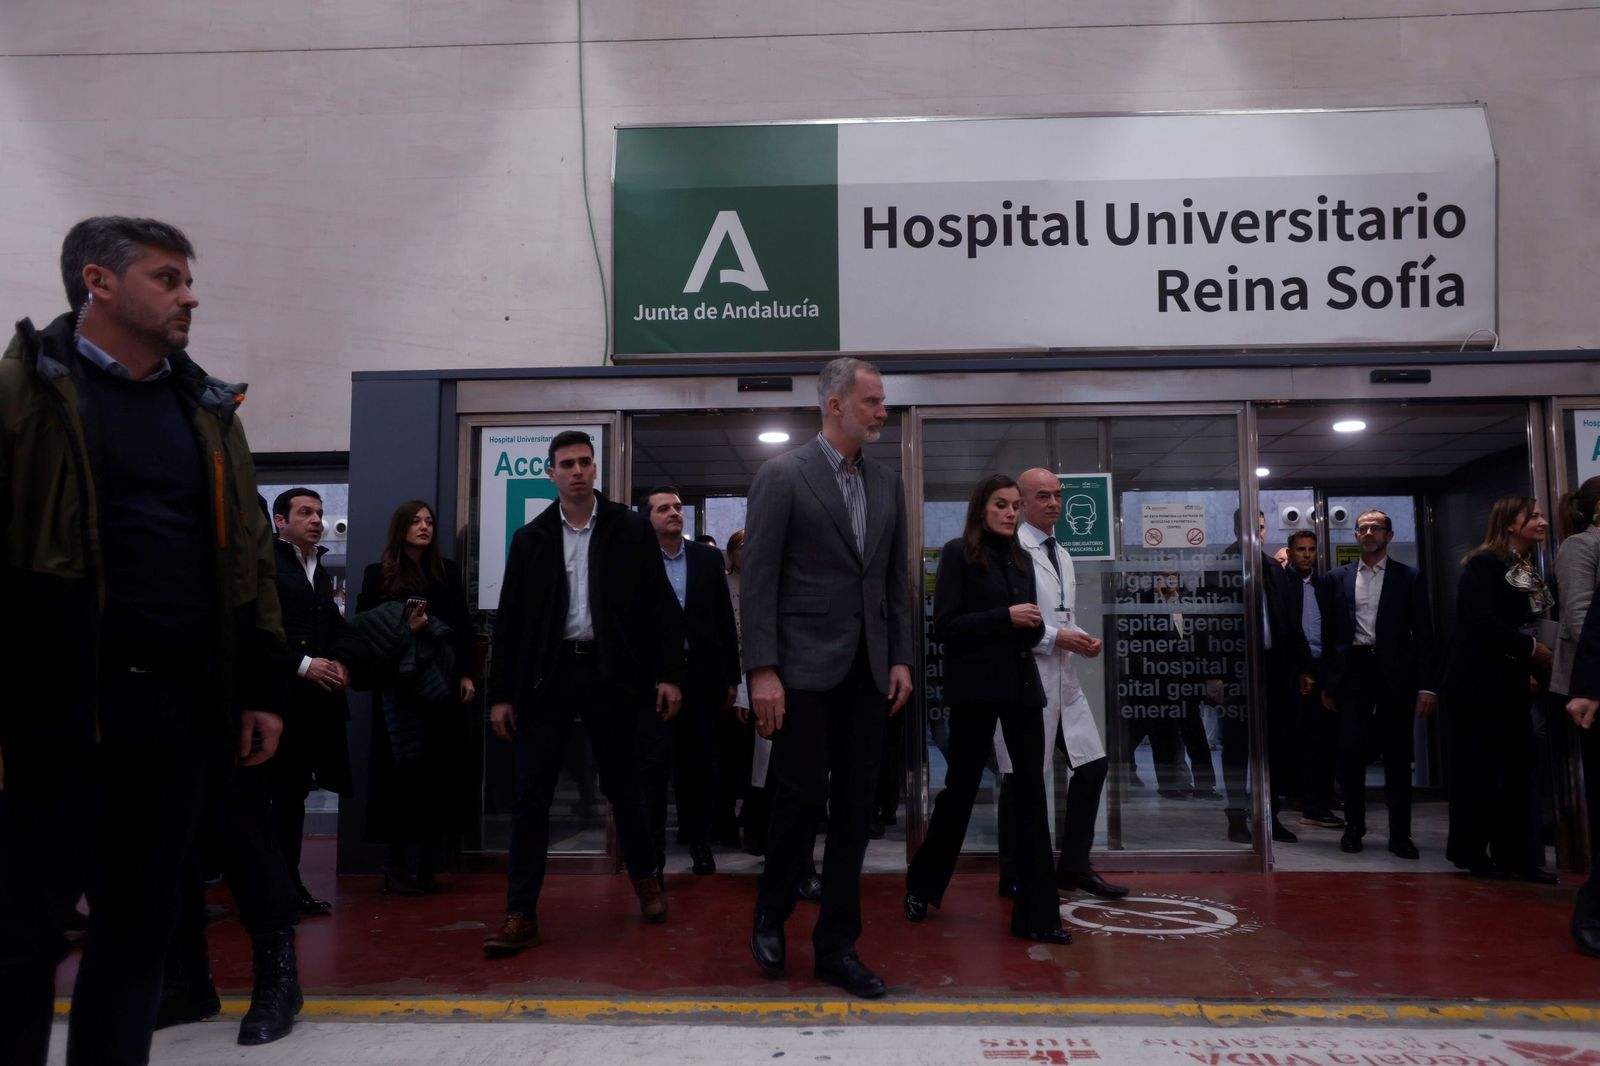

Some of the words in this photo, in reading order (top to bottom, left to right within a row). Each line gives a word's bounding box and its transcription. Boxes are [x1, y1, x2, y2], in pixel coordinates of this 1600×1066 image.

[863, 199, 1089, 259] Hospital
[1105, 192, 1466, 247] Universitario
[1157, 265, 1308, 313] Reina
[1326, 254, 1465, 311] Sofía
[633, 304, 689, 321] Junta
[693, 302, 718, 320] de
[721, 297, 820, 319] Andalucía
[488, 435, 516, 444] Hospital
[516, 434, 554, 443] Universitari
[1116, 636, 1195, 657] general
[1142, 656, 1228, 678] hospital
[1121, 701, 1188, 719] eneral
